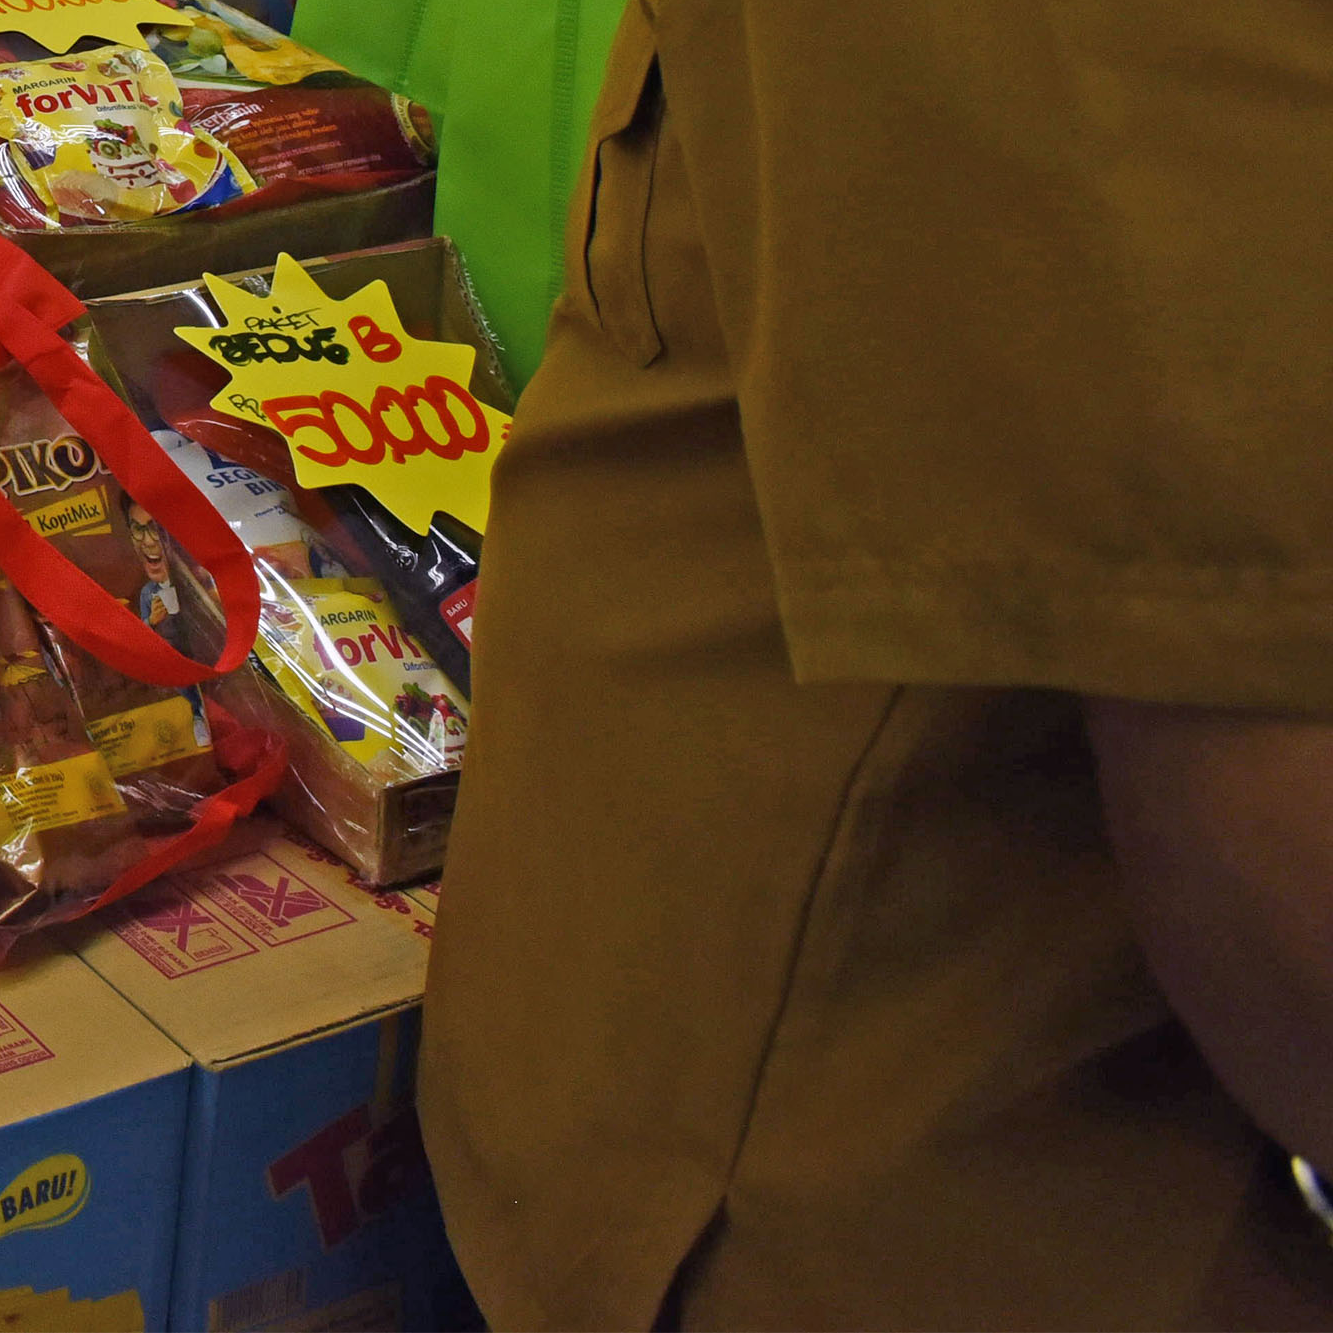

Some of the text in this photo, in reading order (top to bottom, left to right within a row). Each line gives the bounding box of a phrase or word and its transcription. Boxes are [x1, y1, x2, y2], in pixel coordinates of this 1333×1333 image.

[12, 75, 77, 96] MARGARIN
[244, 307, 321, 331] PAKET
[348, 315, 403, 363] B
[37, 501, 102, 533] KopiMix
[315, 609, 377, 628] ARGARIN
[445, 598, 470, 618] BARU
[0, 1169, 79, 1224] BARU!
